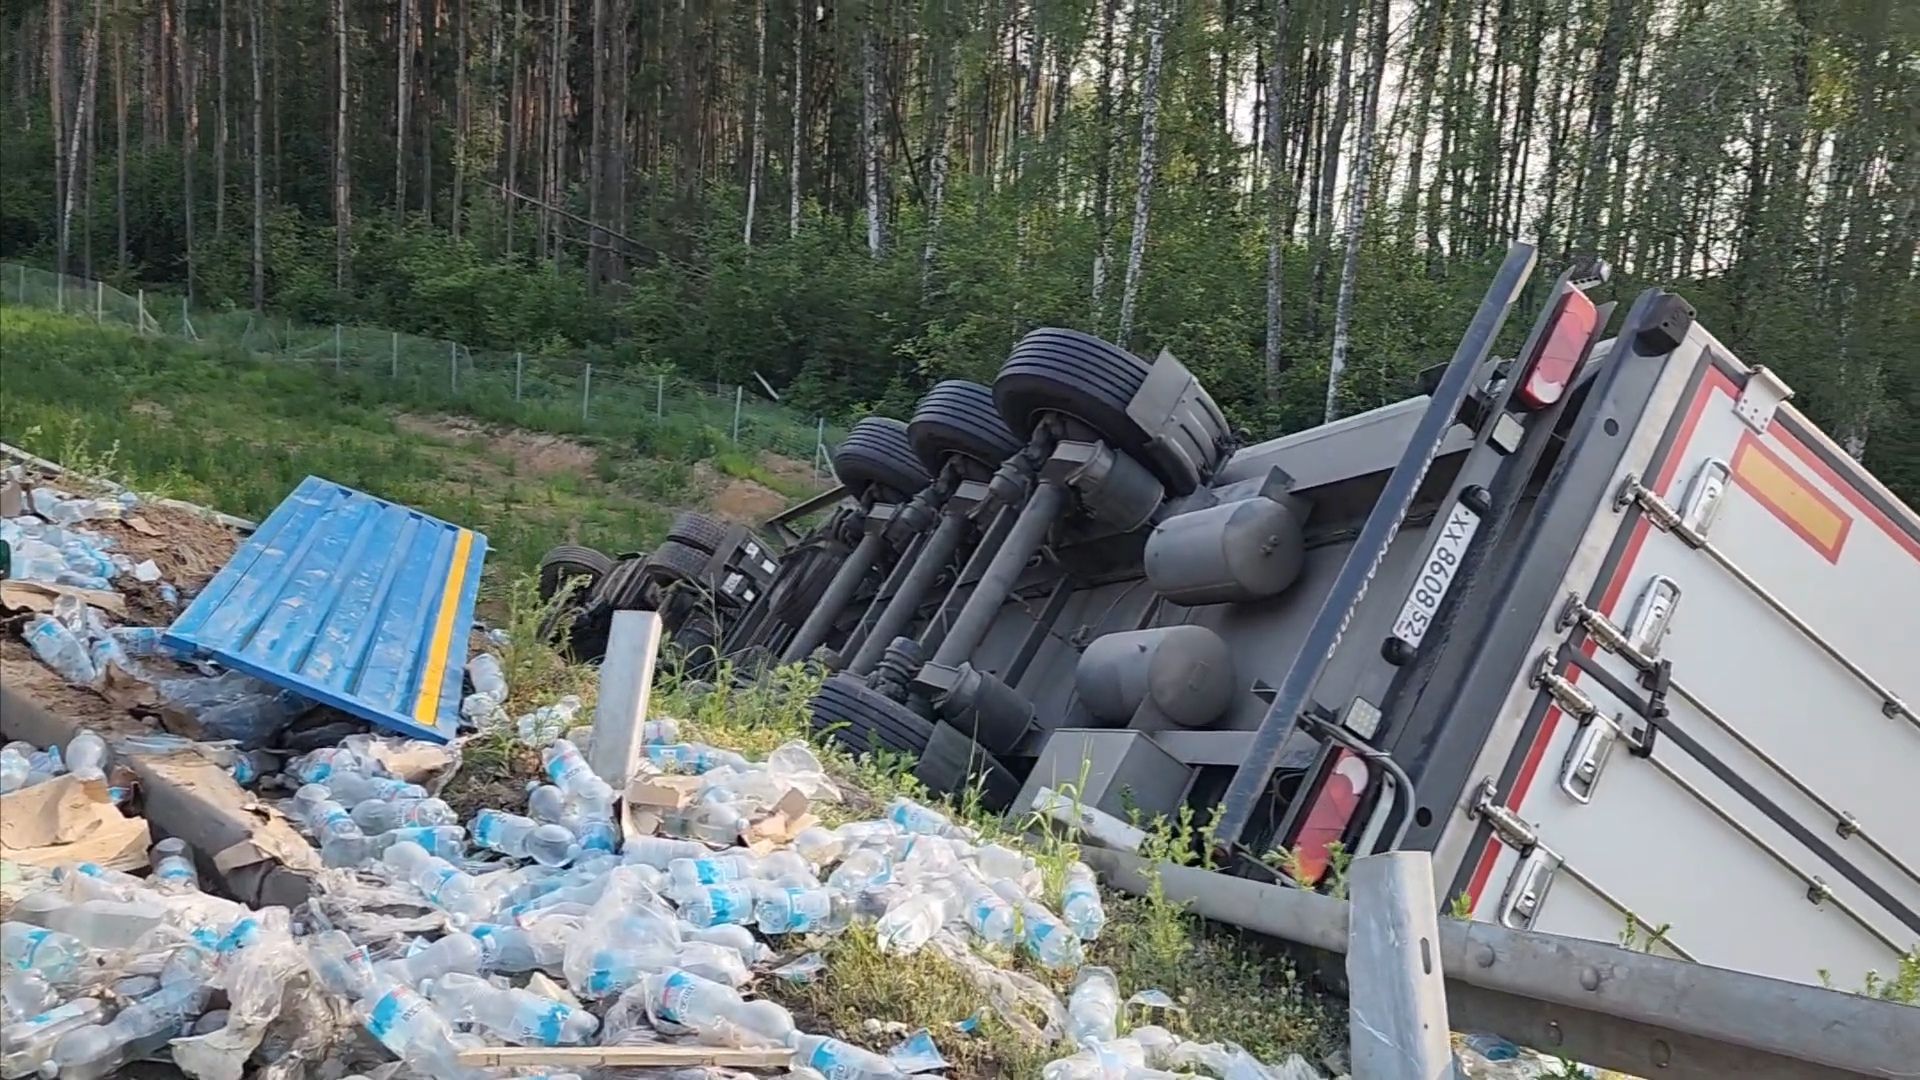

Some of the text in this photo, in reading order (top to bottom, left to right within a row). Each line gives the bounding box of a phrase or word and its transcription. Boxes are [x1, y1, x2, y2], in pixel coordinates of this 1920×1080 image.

[1444, 513, 1470, 547] XX
[1415, 546, 1457, 609] 8608
[1404, 610, 1429, 638] 52
